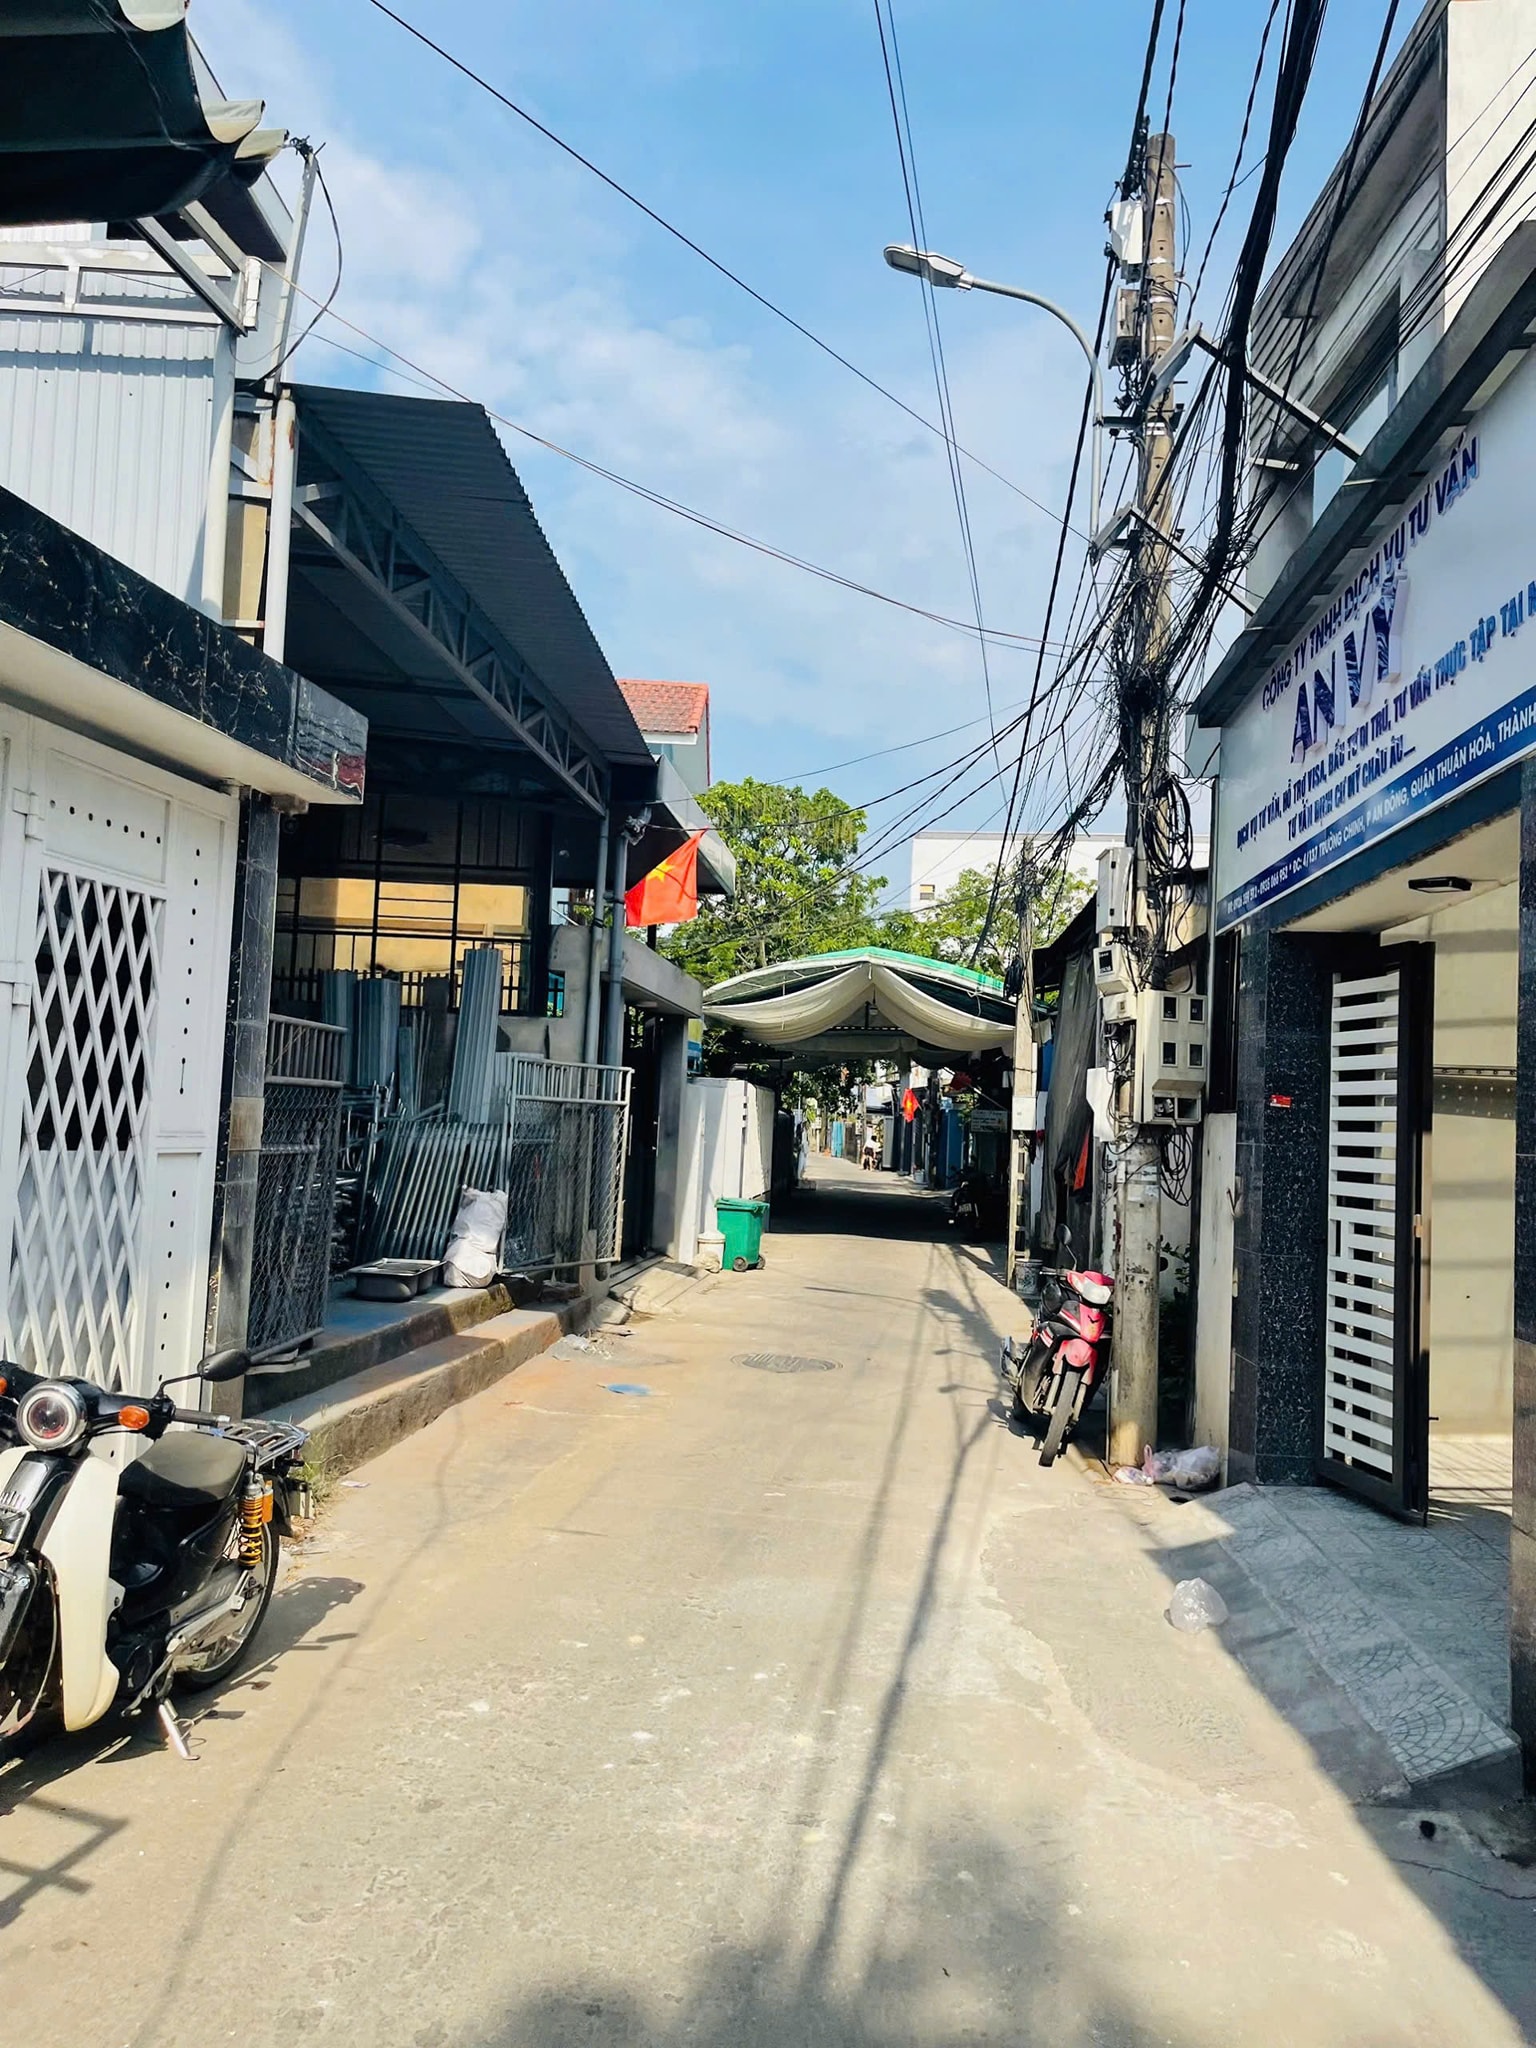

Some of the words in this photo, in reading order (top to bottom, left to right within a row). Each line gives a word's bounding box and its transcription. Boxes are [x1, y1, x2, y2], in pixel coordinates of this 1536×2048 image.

[1292, 637, 1309, 678] TY
[1309, 597, 1342, 661] TNHH
[1409, 483, 1432, 540] TƯ
[1435, 431, 1479, 515] VẤN
[1259, 805, 1267, 832] TƯ
[1308, 760, 1327, 792] VISA,
[1393, 686, 1407, 723] TƯ
[1409, 665, 1432, 710] VẤN
[1434, 640, 1467, 691] THỰC
[1469, 617, 1497, 663] TẬP
[1499, 590, 1525, 638] TẠI
[1371, 805, 1383, 825] AN
[1410, 767, 1435, 799] QUẬN
[1436, 747, 1467, 782] THUẬN
[1468, 726, 1495, 762] HÓA,
[1498, 702, 1536, 743] THÀNH
[1288, 813, 1298, 841] TƯ
